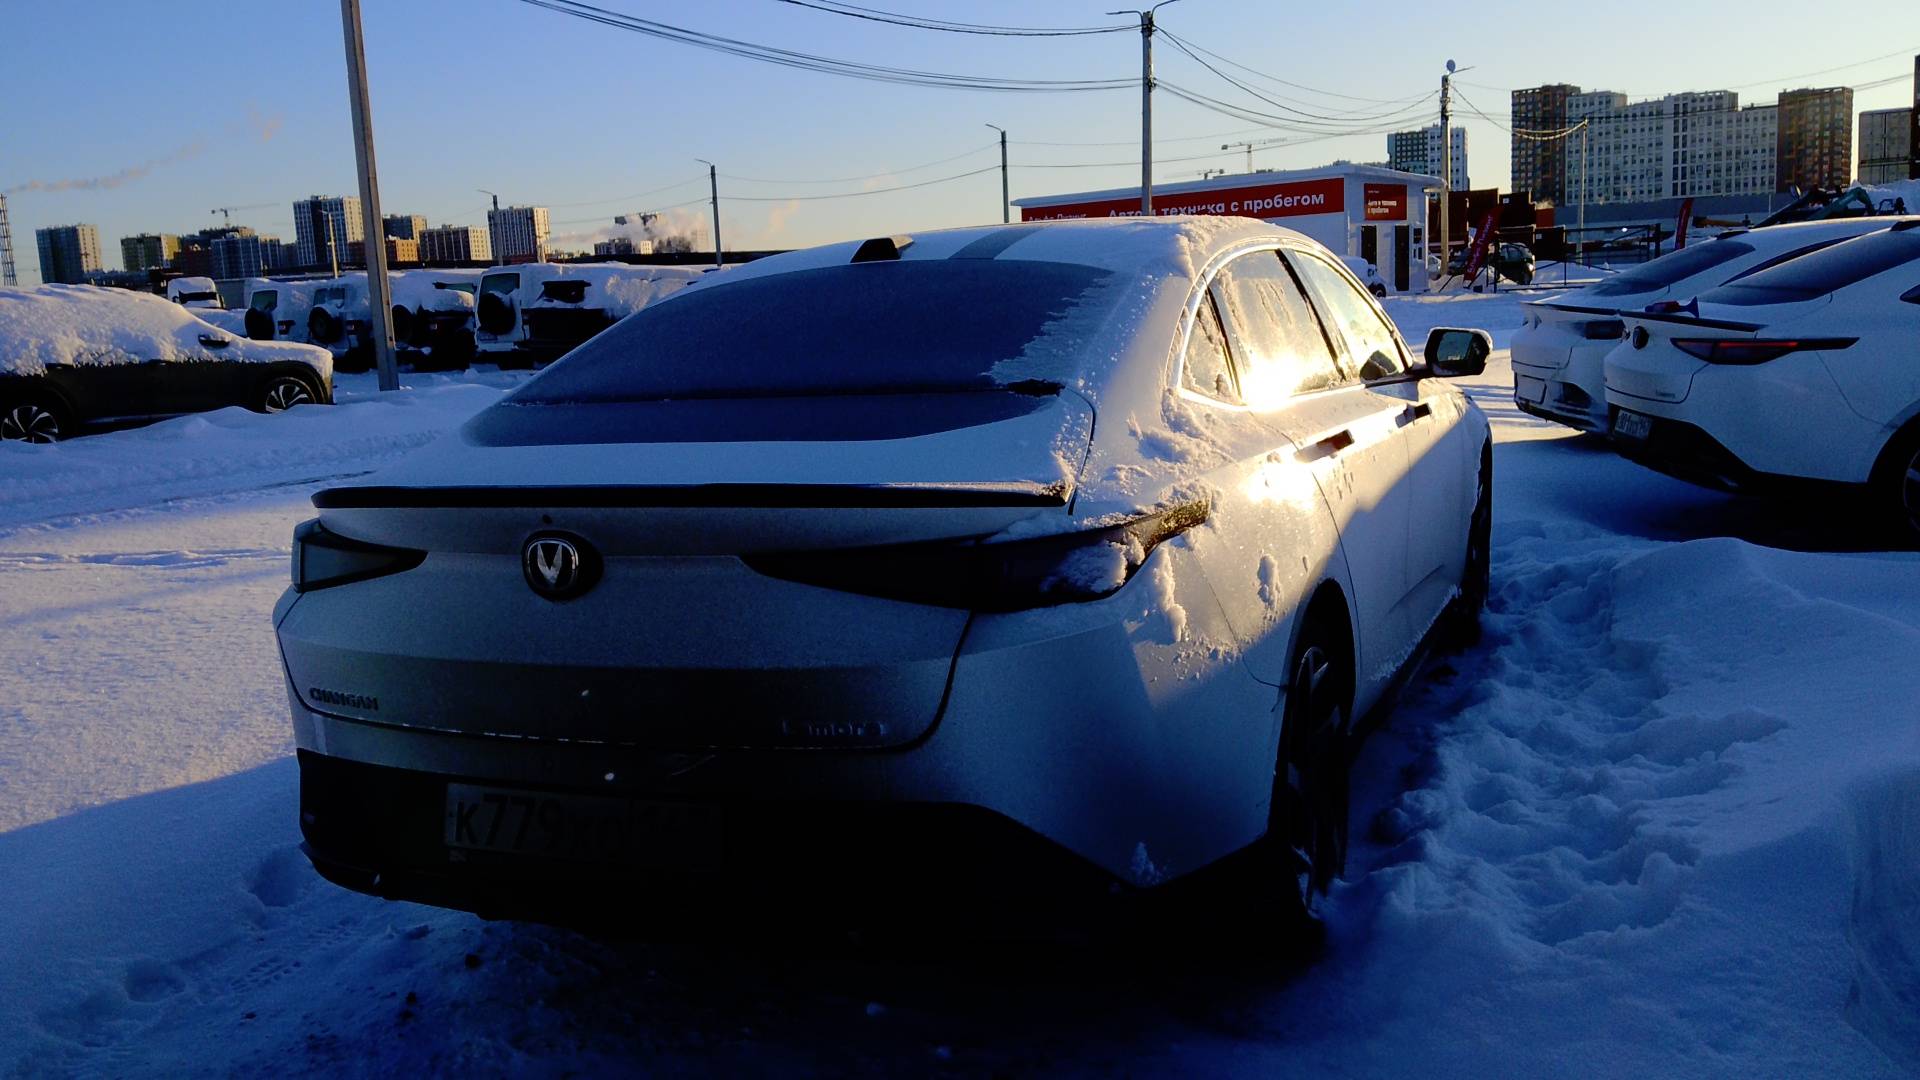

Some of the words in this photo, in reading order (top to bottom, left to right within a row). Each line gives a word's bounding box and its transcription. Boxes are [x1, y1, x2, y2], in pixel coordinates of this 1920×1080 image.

[1230, 201, 1239, 212] с
[1243, 193, 1324, 214] пробегом
[310, 687, 378, 711] CHANGAN
